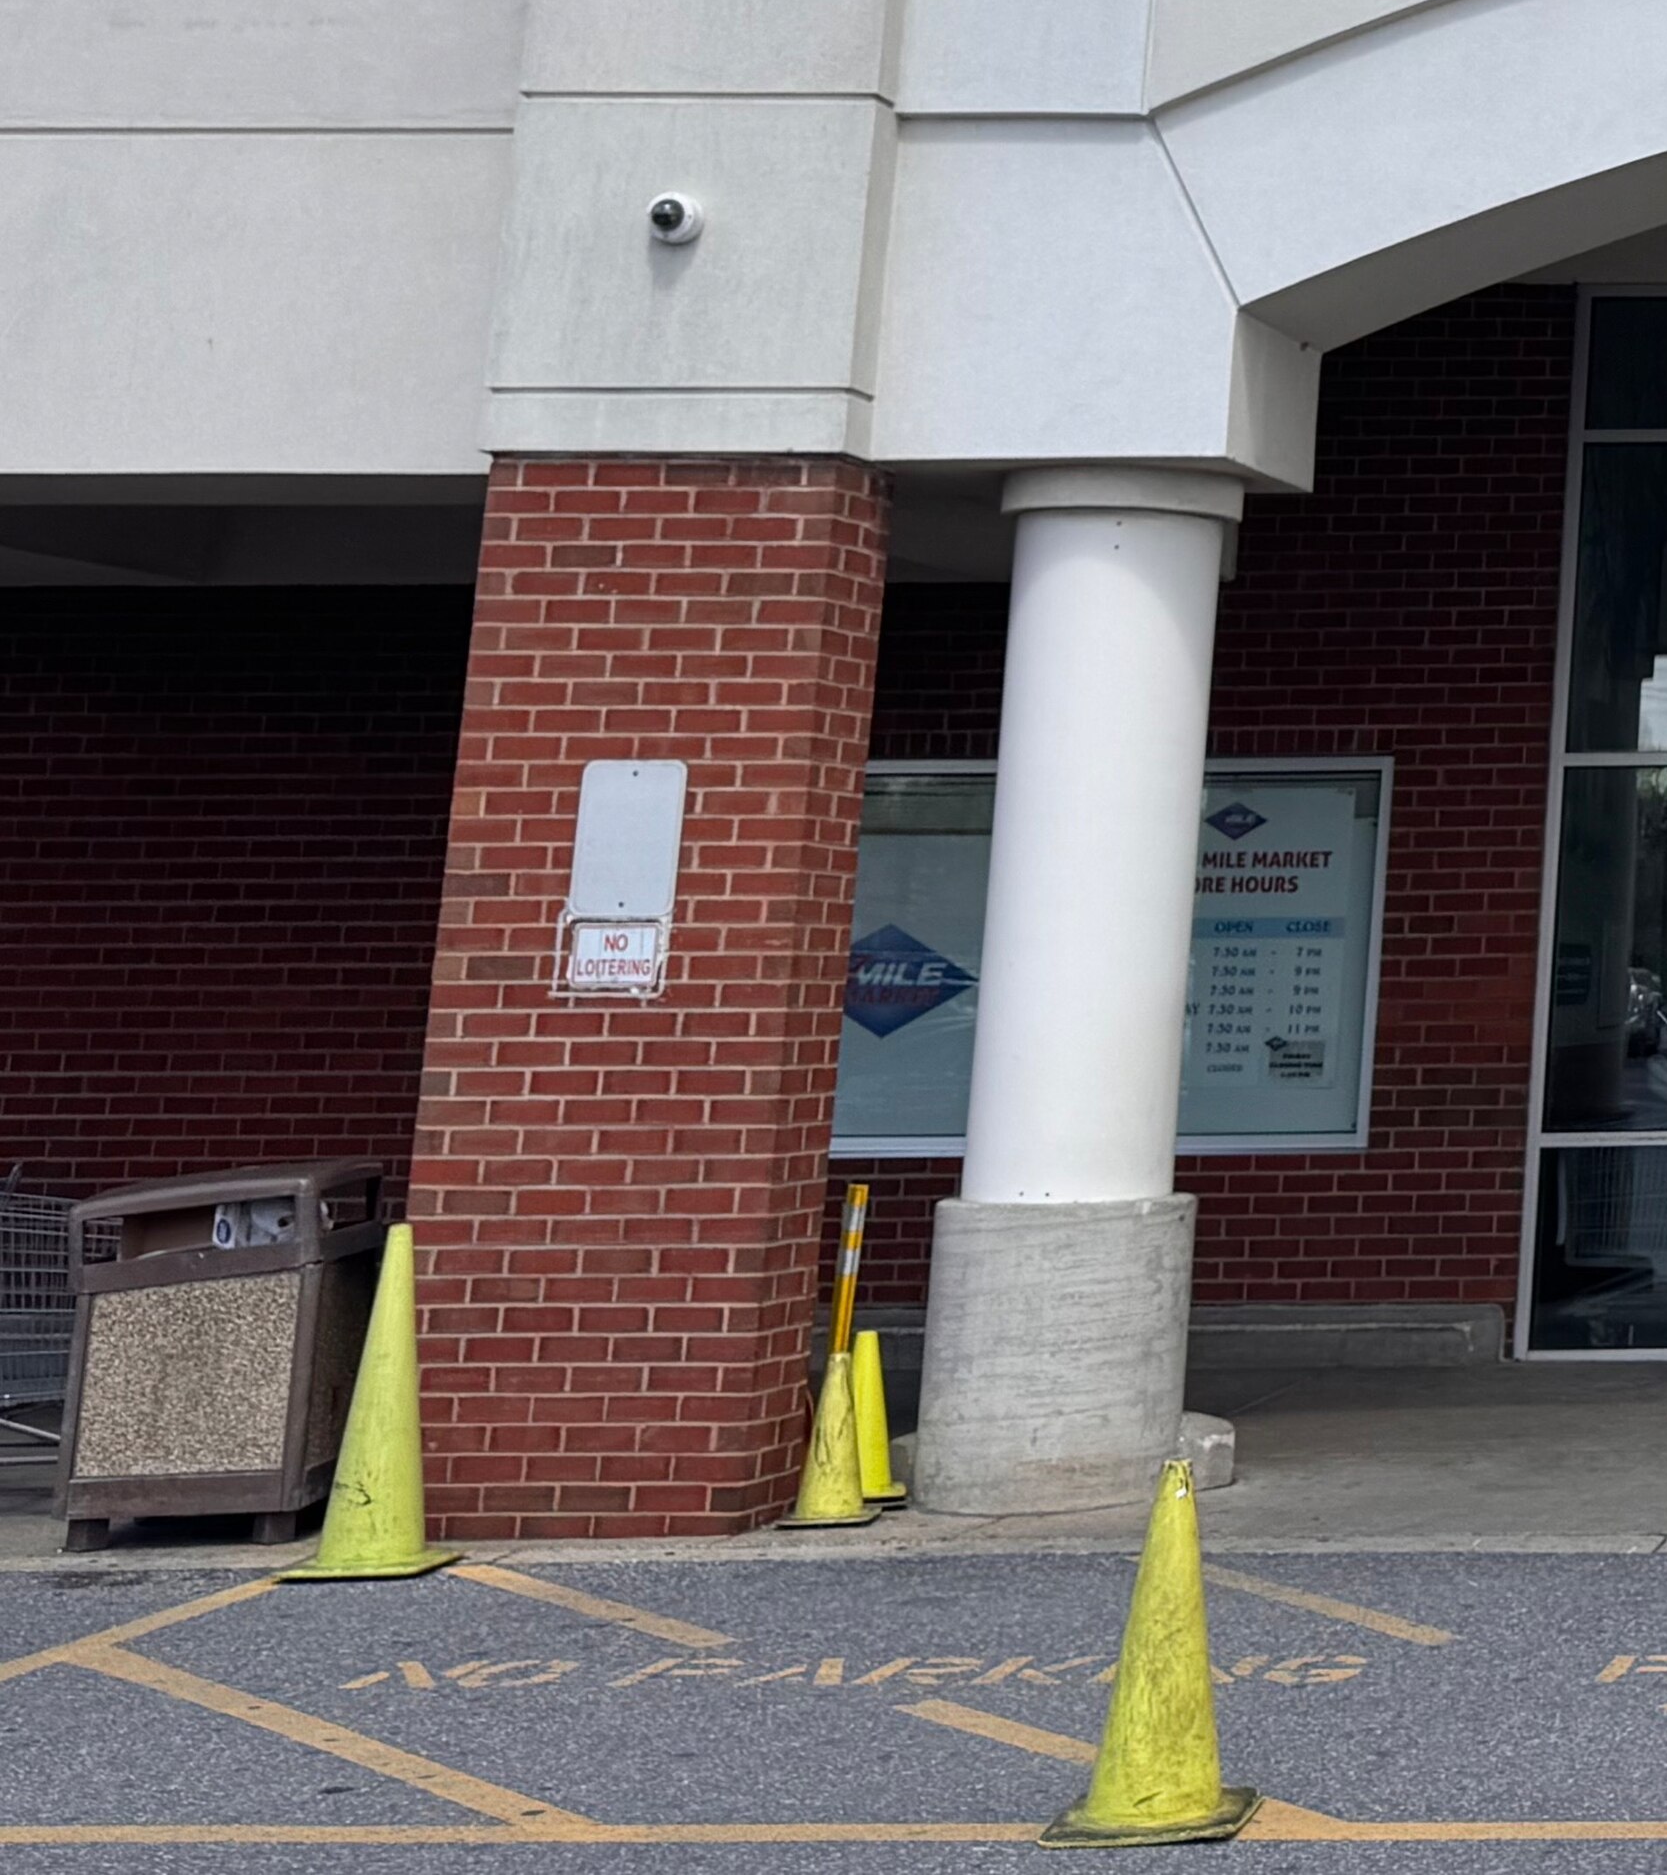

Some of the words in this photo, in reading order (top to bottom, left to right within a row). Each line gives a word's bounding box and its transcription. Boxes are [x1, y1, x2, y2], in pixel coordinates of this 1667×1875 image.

[1201, 851, 1247, 868] MILE
[1251, 850, 1333, 868] MARKET
[1230, 875, 1299, 894] HOURS
[1213, 921, 1254, 933] OPEN
[1286, 920, 1330, 933] CLOSE
[603, 933, 629, 953] NO
[576, 958, 652, 976] LOITERING
[857, 961, 948, 986] MILE
[338, 1659, 581, 1690] NO
